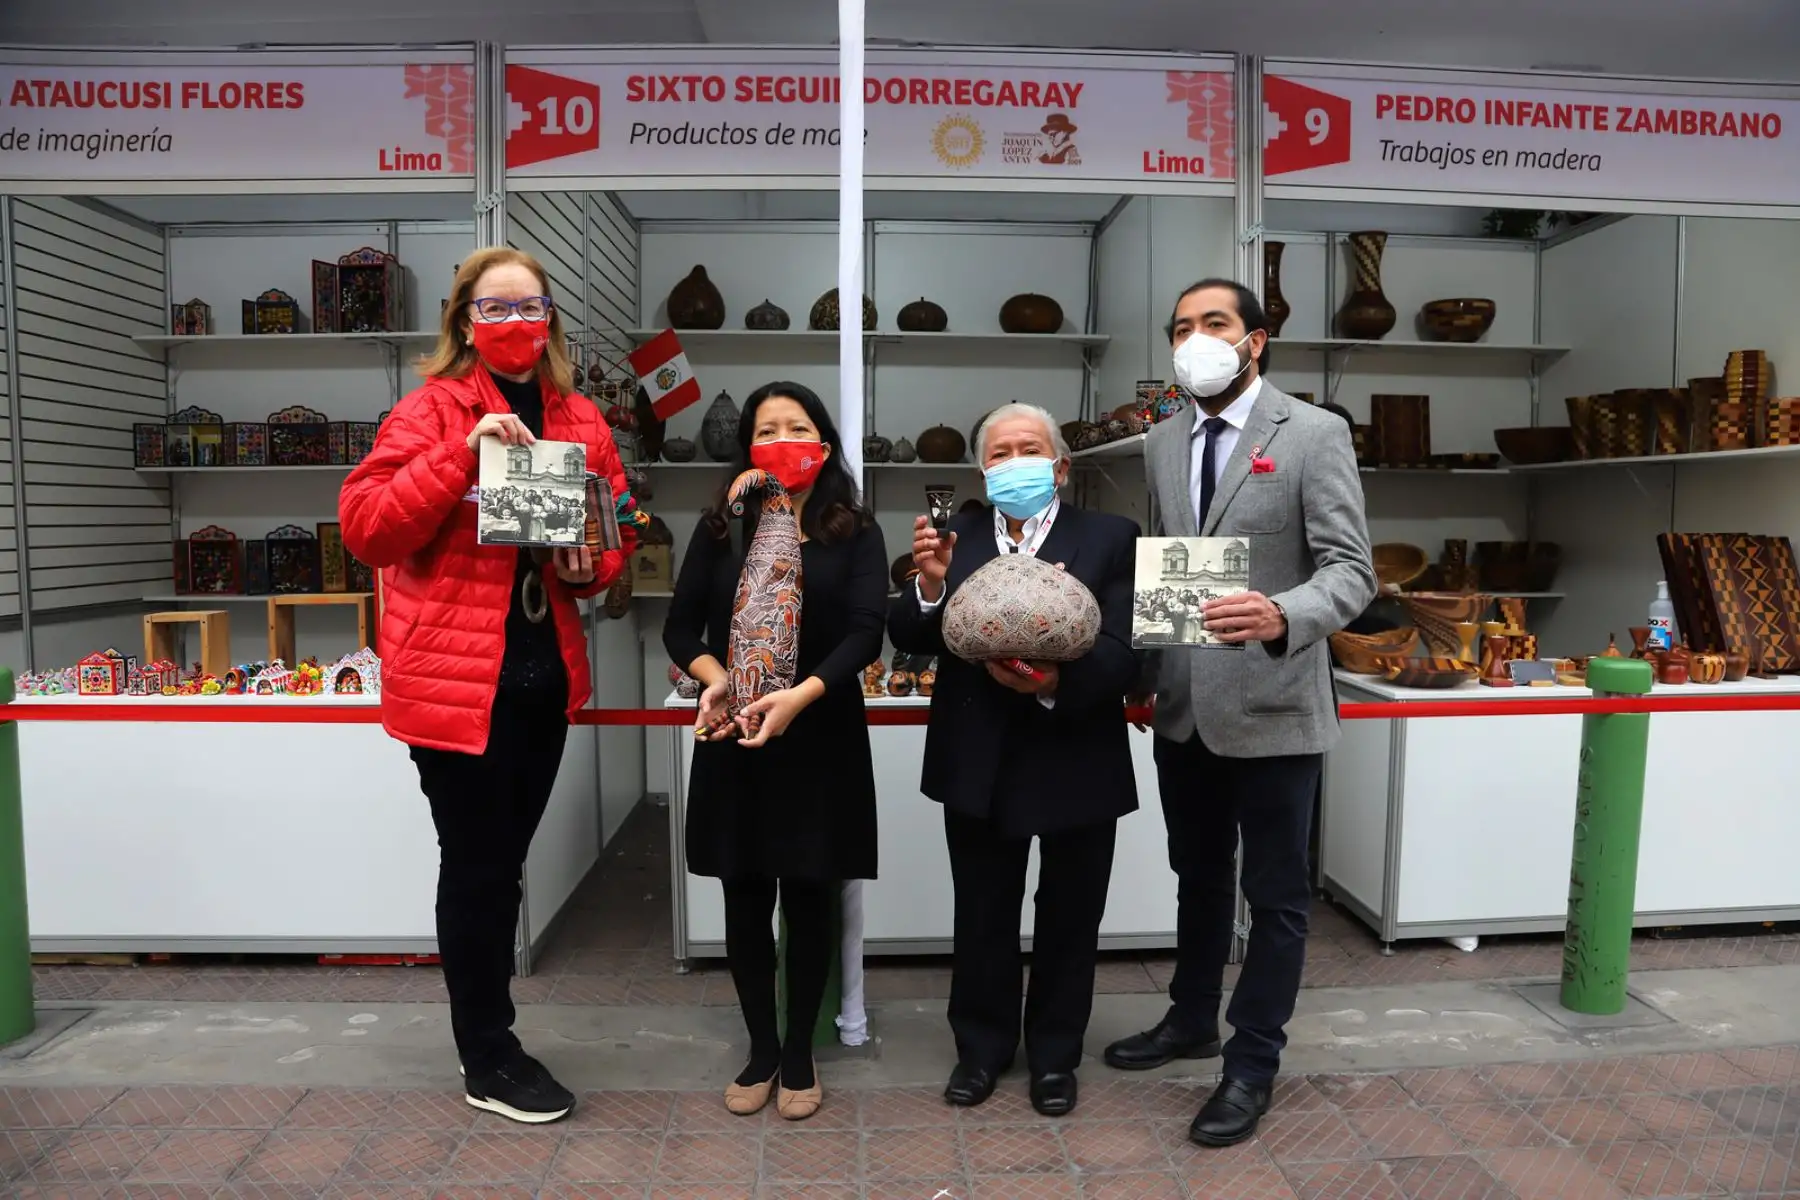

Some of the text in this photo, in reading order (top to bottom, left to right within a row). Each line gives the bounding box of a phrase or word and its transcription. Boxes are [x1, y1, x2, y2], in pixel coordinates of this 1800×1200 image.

[10, 79, 305, 110] ATAUCUSI FLORES
[627, 75, 726, 103] SIXTO
[863, 76, 1084, 110] DORREGARAY
[539, 96, 594, 135] 10
[1304, 107, 1330, 145] 9
[1376, 93, 1782, 139] PEDRO INFANTE ZAMBRANO
[0, 127, 173, 160] de imaginería
[629, 121, 758, 146] Productos
[765, 121, 796, 146] de
[379, 146, 443, 172] Lima
[1143, 149, 1206, 175] Lima
[1379, 139, 1602, 172] Trabajos en madera
